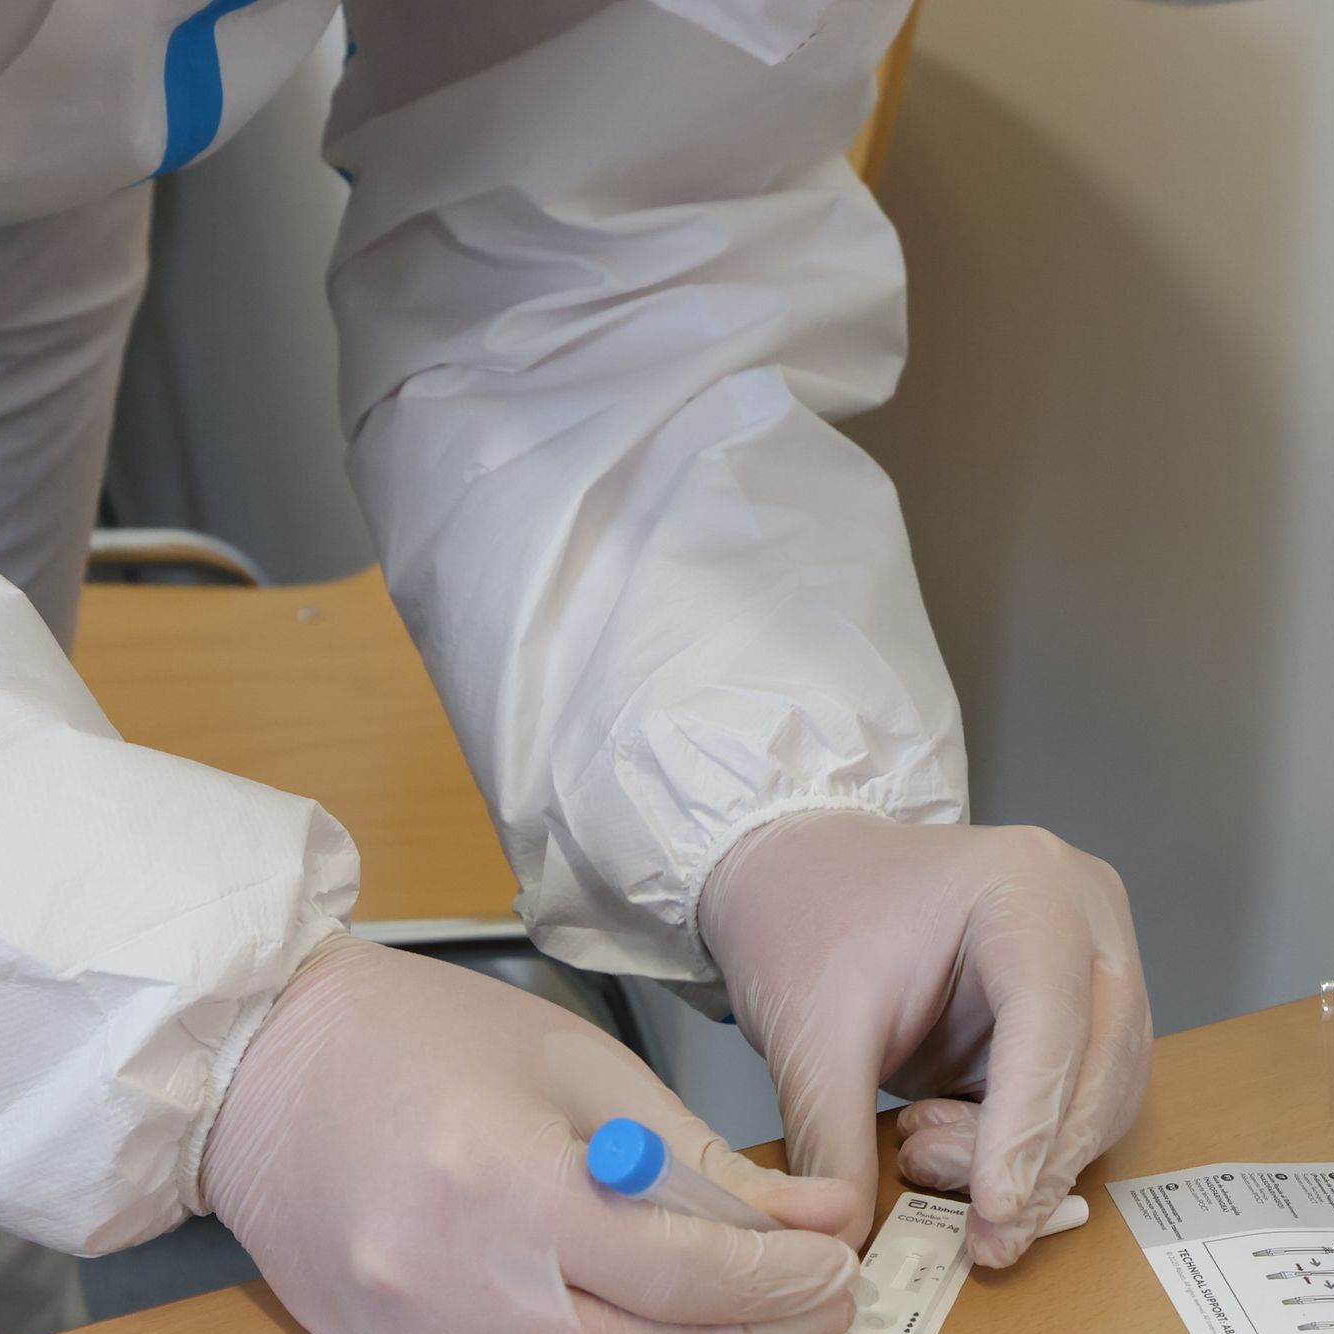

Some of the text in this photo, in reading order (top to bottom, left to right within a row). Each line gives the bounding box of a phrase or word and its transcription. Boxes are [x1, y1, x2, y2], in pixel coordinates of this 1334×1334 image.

[929, 1205, 964, 1216] Abbott
[898, 1215, 960, 1233] COVID-19 Ag
[1177, 1248, 1208, 1289] TECHNICAL
[1200, 1287, 1229, 1325] SUPPORT:
